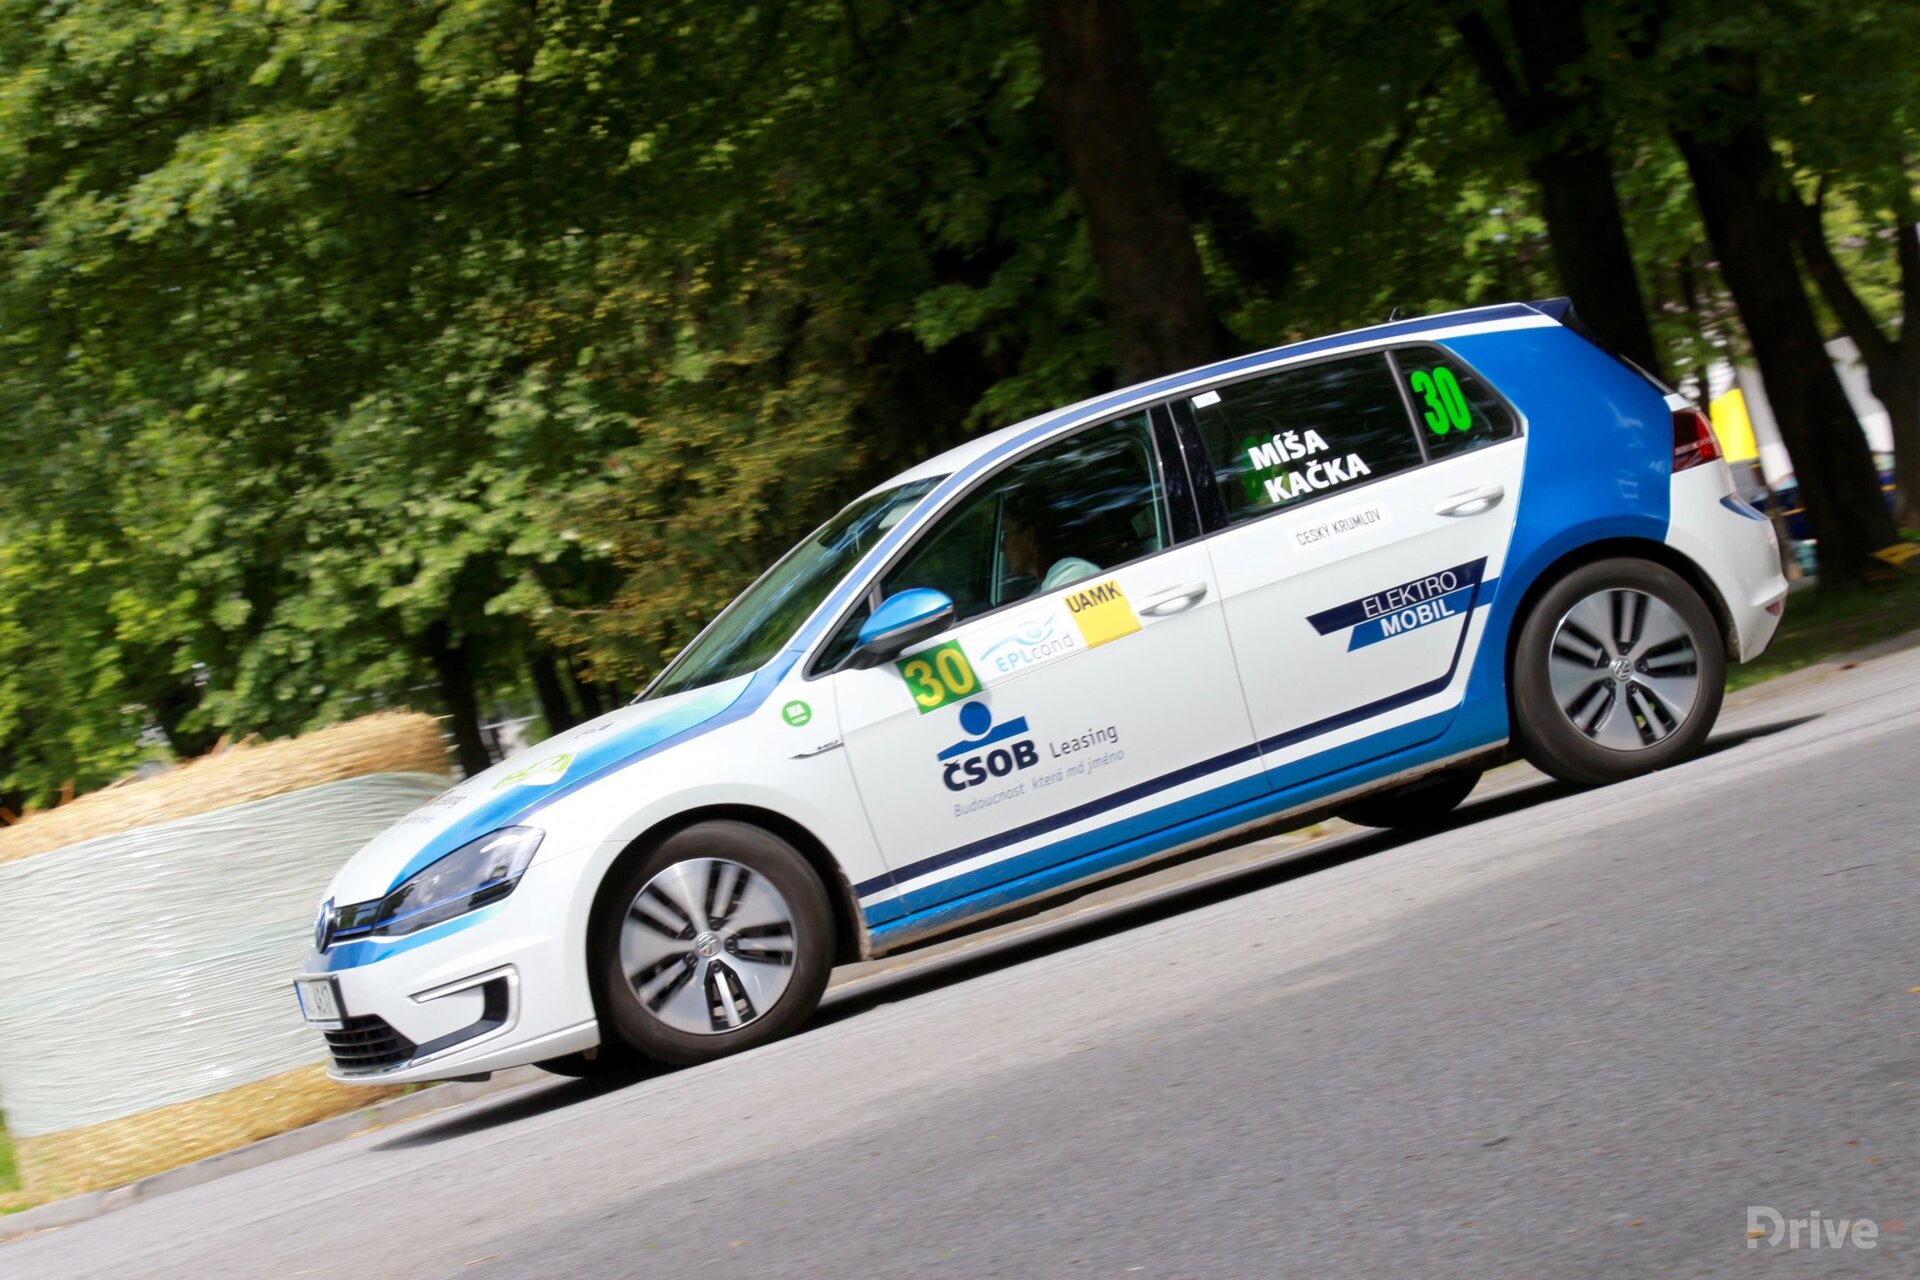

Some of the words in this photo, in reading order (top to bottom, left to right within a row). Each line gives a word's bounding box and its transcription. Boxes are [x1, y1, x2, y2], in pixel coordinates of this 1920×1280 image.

[1410, 366, 1472, 435] 30
[1248, 429, 1329, 471] MÍŠA
[1264, 453, 1371, 503] KAČKA
[1296, 523, 1330, 546] ČESKÝ
[1331, 508, 1381, 534] KRUMLOV
[1362, 571, 1457, 619] ELEKTRO
[1379, 598, 1455, 637] MOBIL
[904, 647, 975, 707] 30
[995, 634, 1075, 672] EPLcond
[943, 739, 1039, 792] ČSOB
[1050, 724, 1119, 758] Leasing
[954, 784, 1025, 817] Budoucnost
[1087, 747, 1125, 775] jméno
